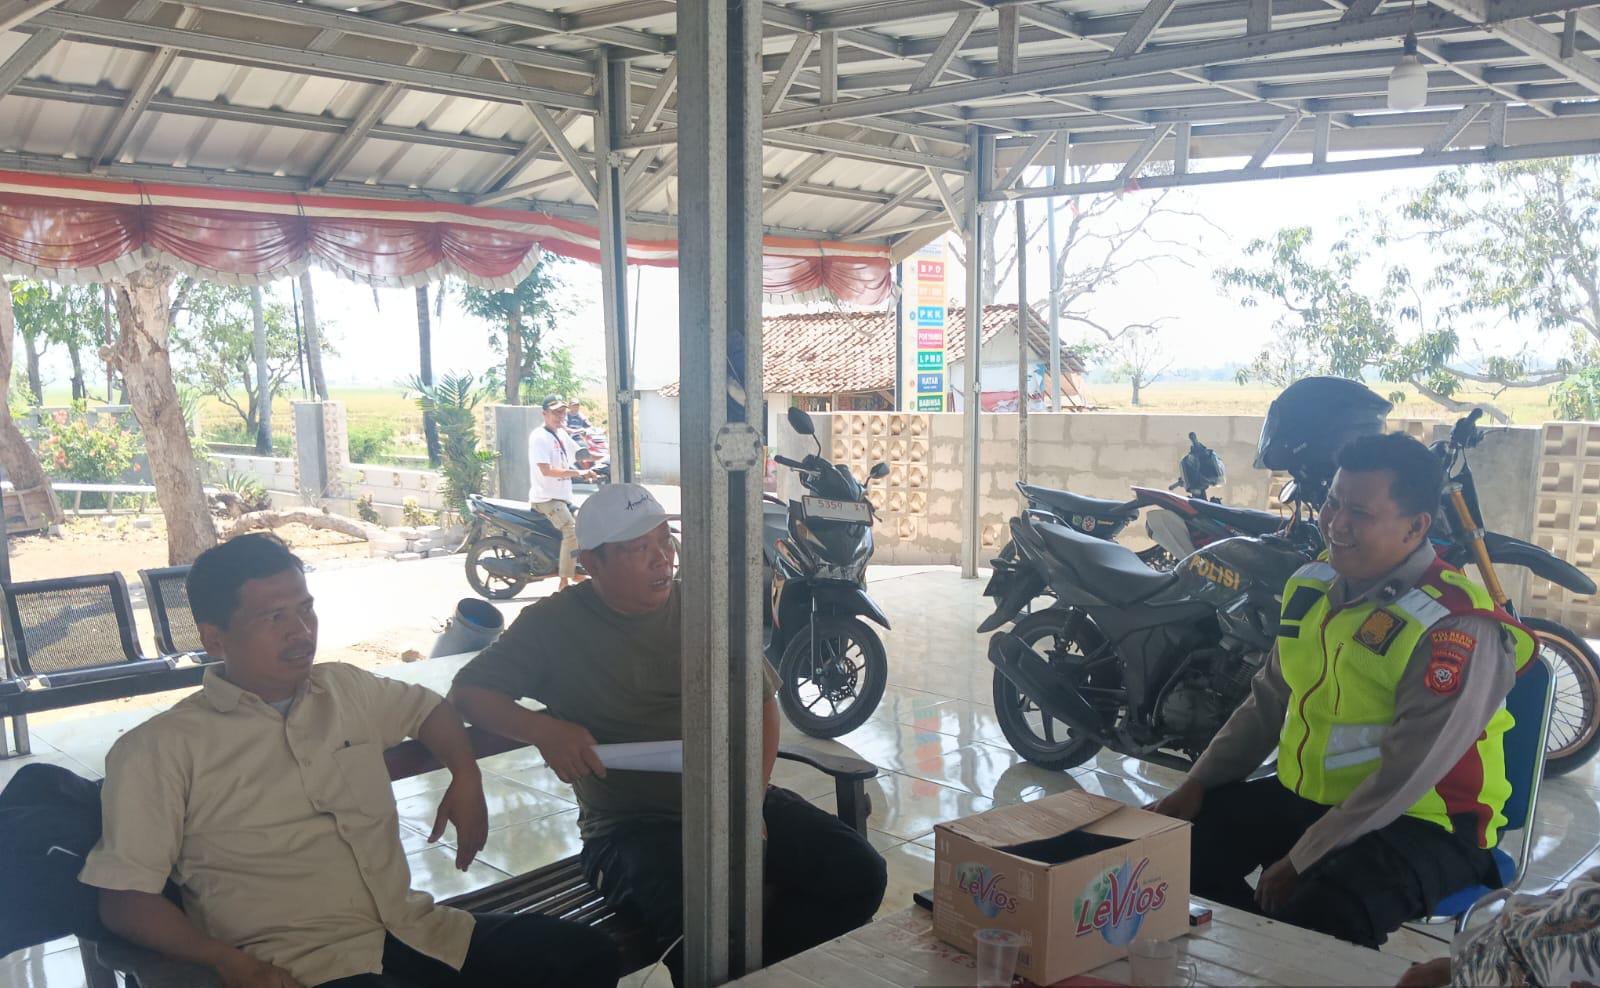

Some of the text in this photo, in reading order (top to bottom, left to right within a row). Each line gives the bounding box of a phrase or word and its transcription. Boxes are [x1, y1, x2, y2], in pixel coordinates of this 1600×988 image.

[1189, 554, 1241, 591] POLISI
[958, 867, 1018, 914] LeVios
[1075, 857, 1168, 937] LeVios
